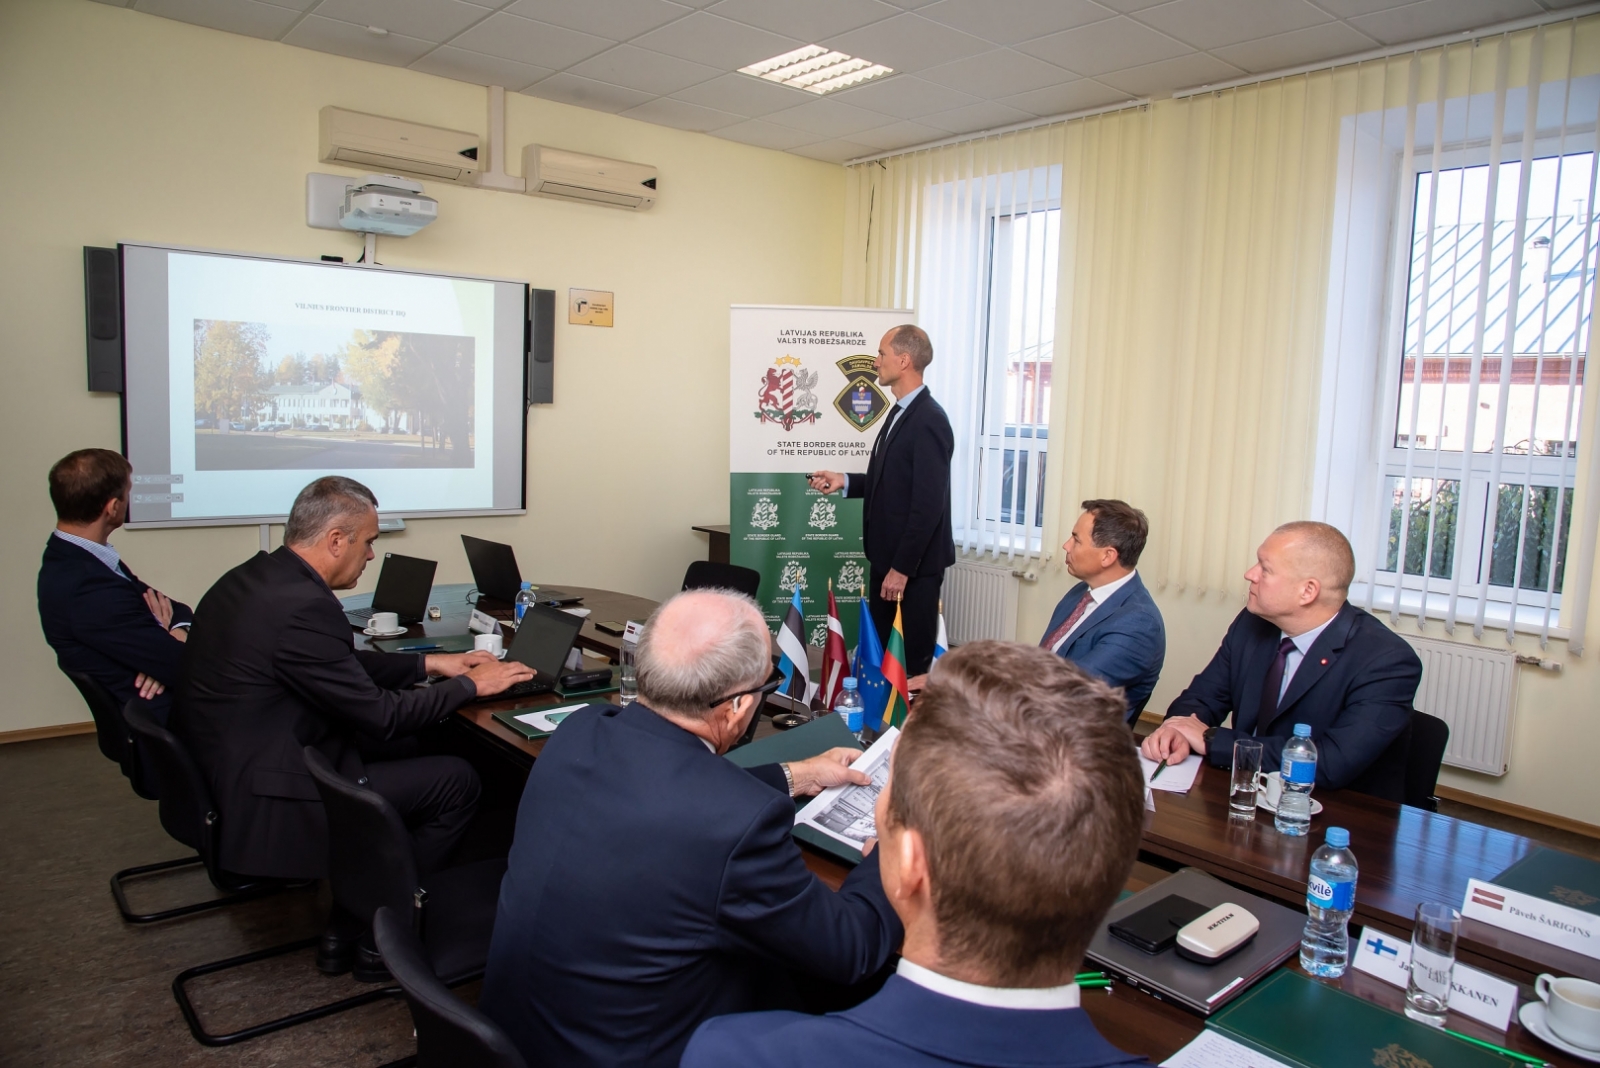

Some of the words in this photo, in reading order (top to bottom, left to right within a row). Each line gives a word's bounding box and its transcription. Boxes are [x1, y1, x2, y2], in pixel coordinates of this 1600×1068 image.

[295, 302, 324, 311] VILNIUS
[325, 304, 362, 314] FRONTIER
[362, 308, 394, 316] DISTRICT
[1509, 906, 1537, 922] Pāvels
[1538, 914, 1591, 938] ŠARIGINS
